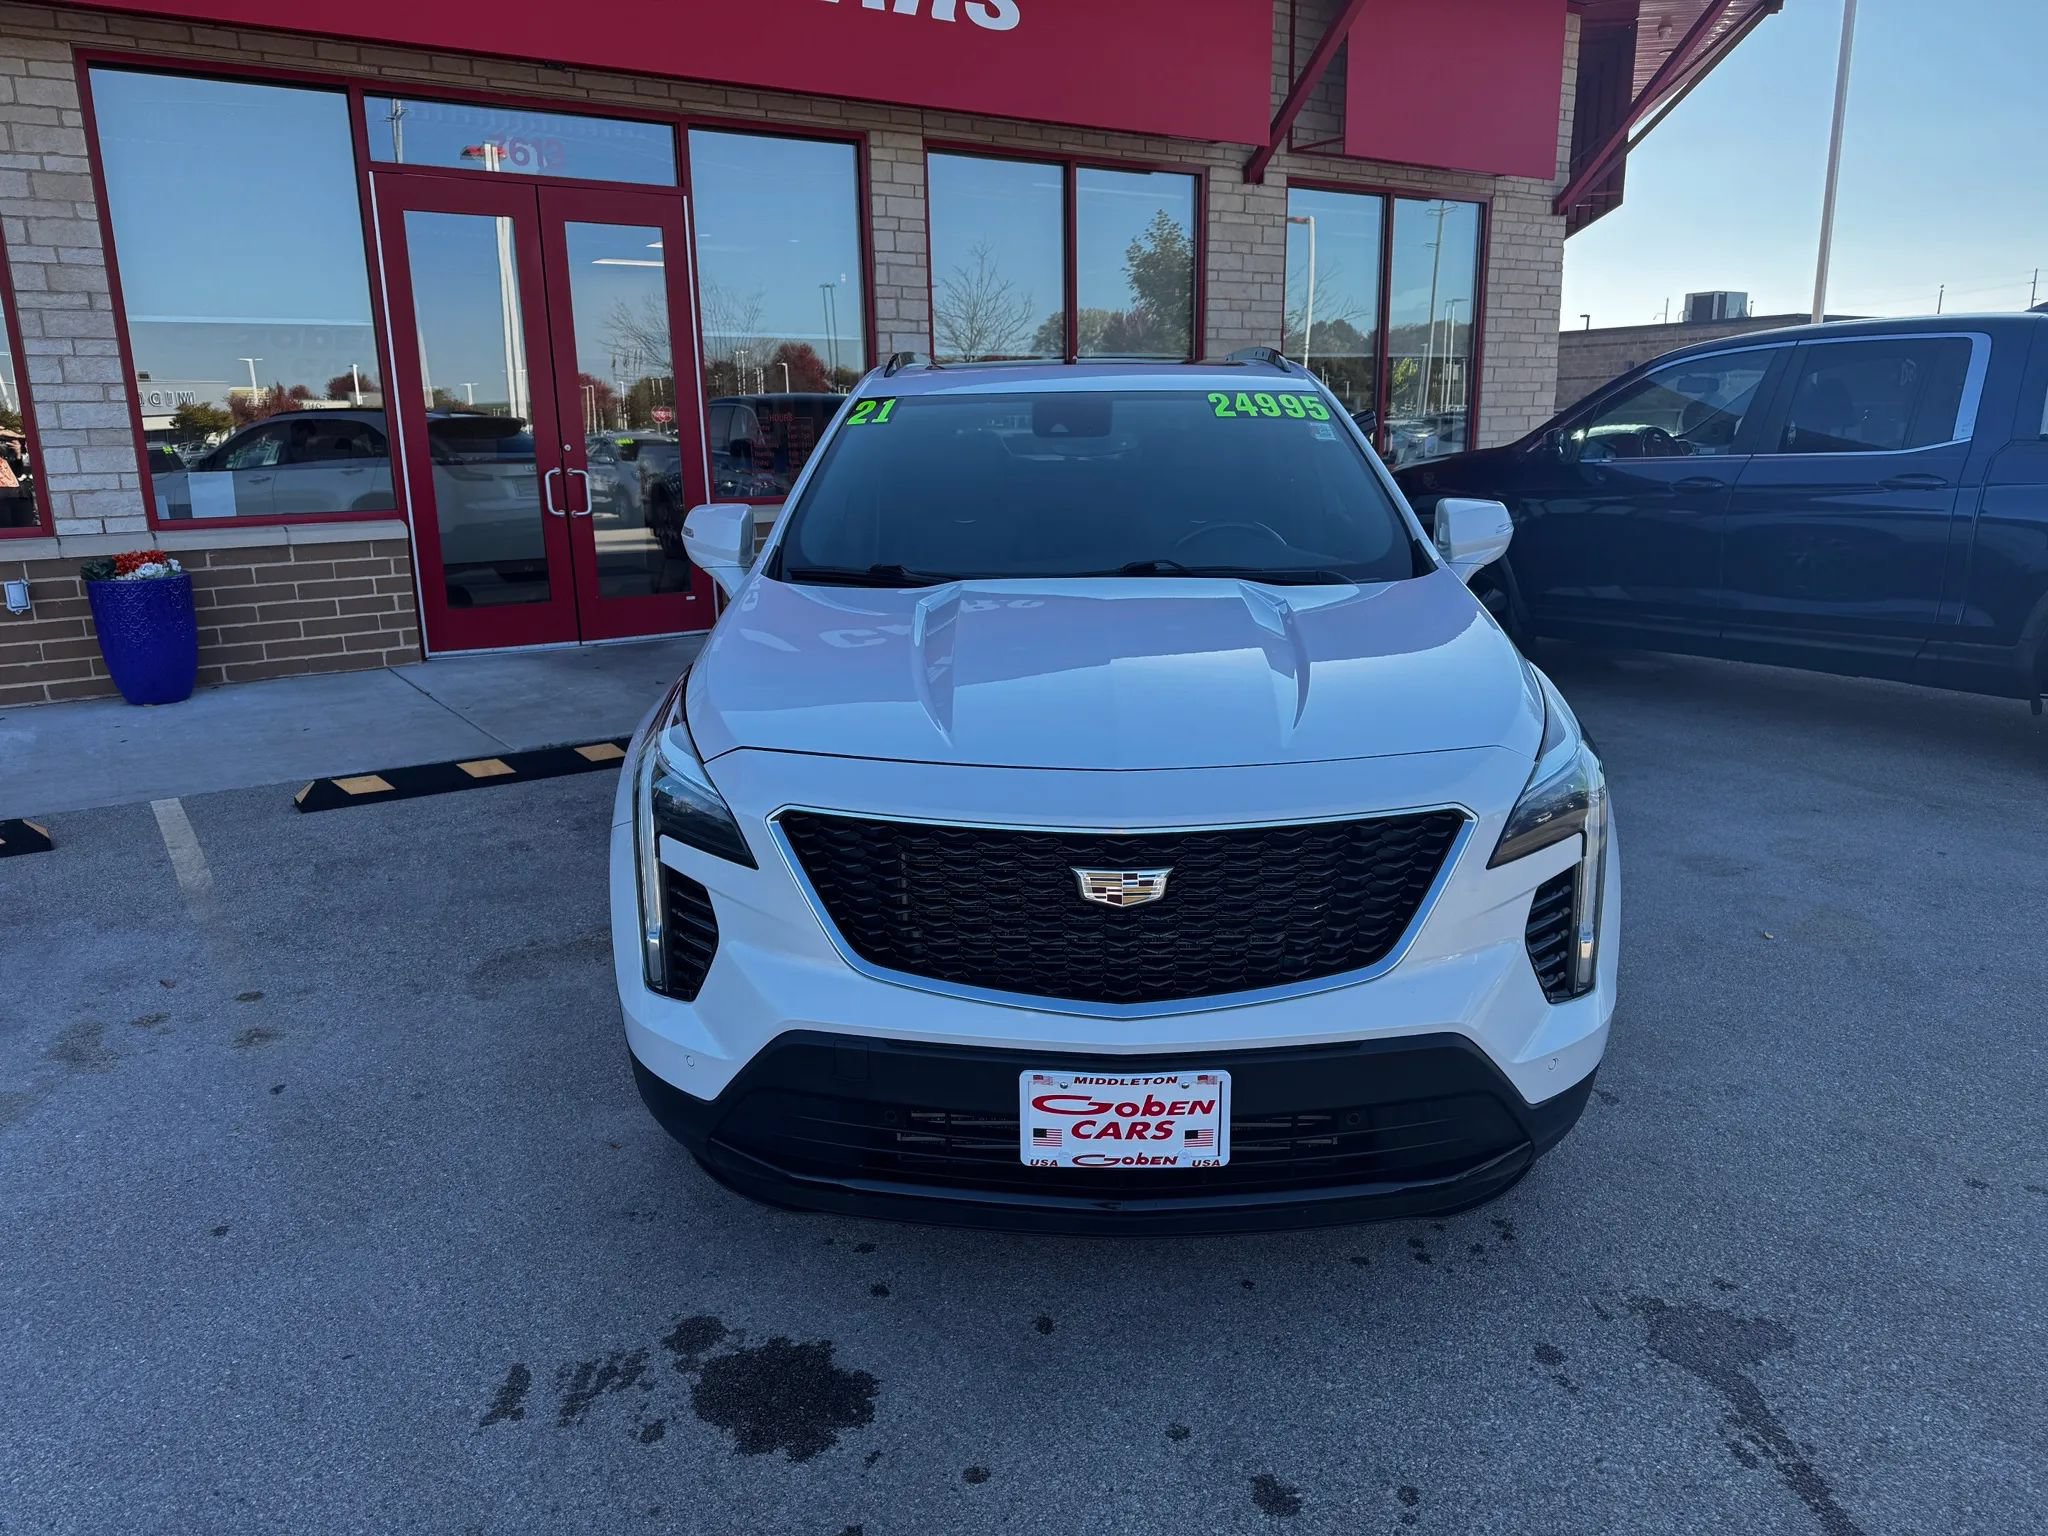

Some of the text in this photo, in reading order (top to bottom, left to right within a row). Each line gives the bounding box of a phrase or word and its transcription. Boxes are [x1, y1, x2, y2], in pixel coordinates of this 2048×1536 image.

[848, 400, 894, 424] 21
[1209, 394, 1328, 419] 24995
[1073, 1075, 1178, 1086] MIDDLETON
[1071, 1119, 1176, 1141] CARS
[1030, 1159, 1059, 1168] USA
[1192, 1159, 1221, 1168] USA
